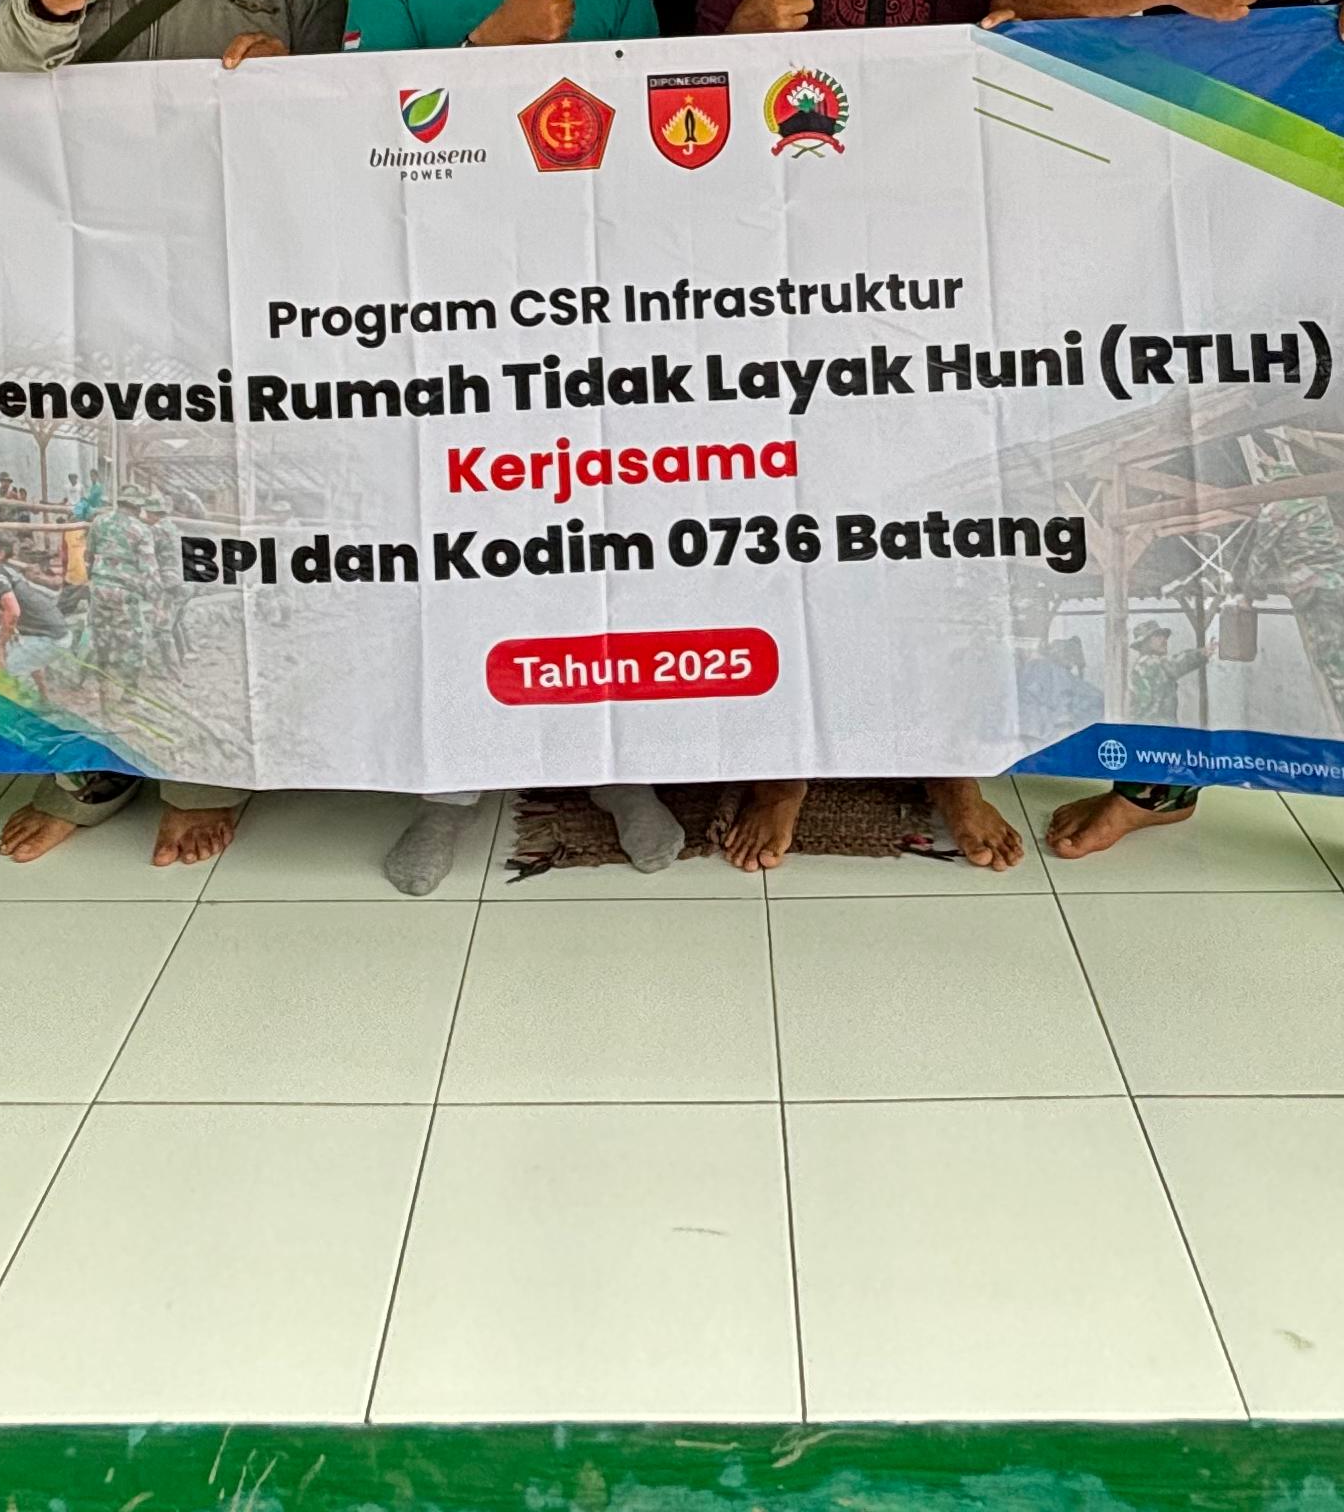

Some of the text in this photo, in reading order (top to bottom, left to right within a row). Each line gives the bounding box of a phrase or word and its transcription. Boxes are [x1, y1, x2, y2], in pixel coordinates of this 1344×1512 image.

[650, 76, 726, 87] DIPONEGORO
[370, 148, 487, 167] bhimasena
[400, 169, 453, 181] POWER
[269, 273, 963, 349] Program CSR Infrastruktur
[247, 364, 490, 422] Rumah
[502, 354, 695, 411] Tidak
[706, 345, 915, 415] Layak
[926, 330, 1084, 393] Huni
[1100, 320, 1333, 400] (RTLH)
[448, 437, 798, 503] Kerjasama
[180, 511, 1087, 585] BPI dan Kodim 0736 Batang
[513, 649, 752, 689] Tahun 2025
